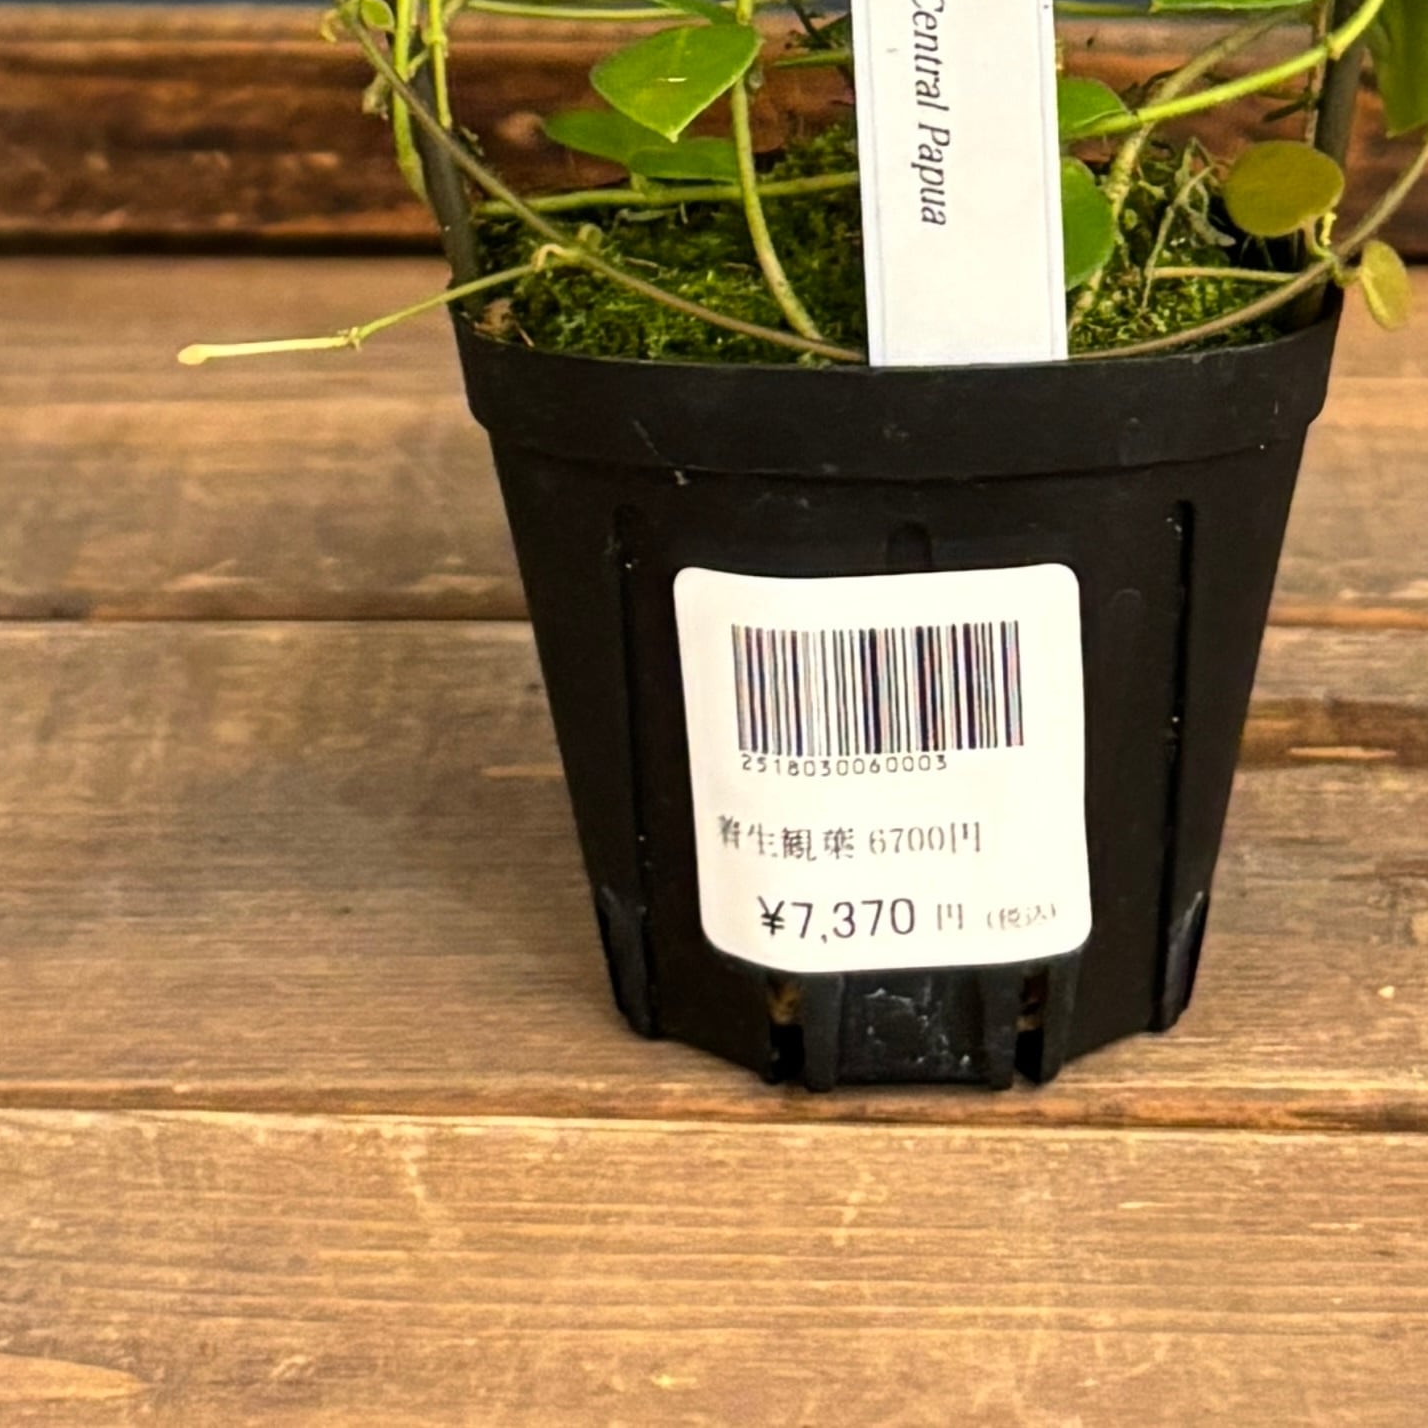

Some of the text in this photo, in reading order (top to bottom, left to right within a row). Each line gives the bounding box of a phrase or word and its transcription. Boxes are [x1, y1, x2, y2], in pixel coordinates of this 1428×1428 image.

[910, 122, 952, 227] Papua
[740, 753, 948, 777] 2518030060003
[757, 896, 915, 943] ¥7,370
